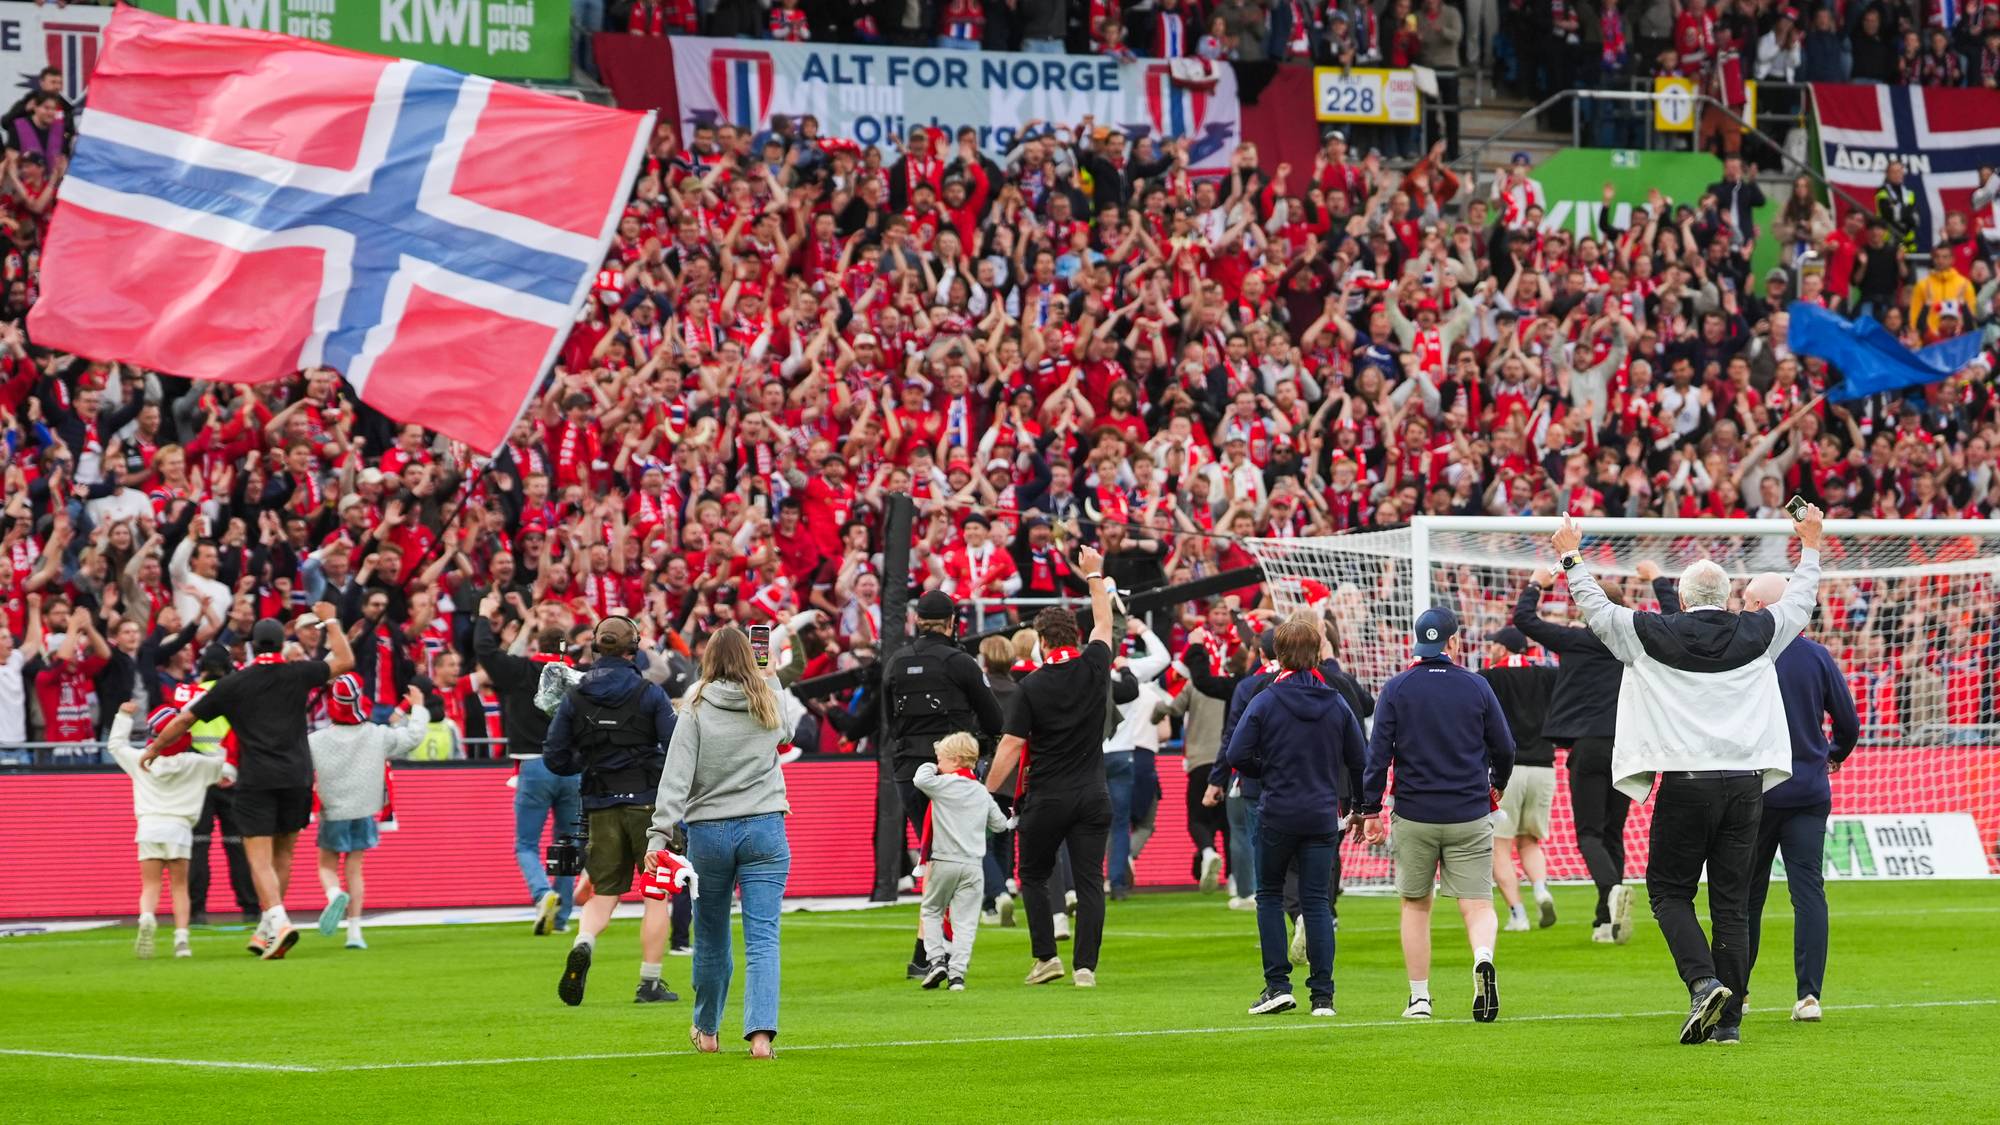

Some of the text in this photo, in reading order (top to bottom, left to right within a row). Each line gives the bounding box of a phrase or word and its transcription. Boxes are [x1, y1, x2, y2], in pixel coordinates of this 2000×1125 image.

[380, 0, 481, 47] KIWI
[488, 0, 534, 26] mini
[488, 25, 530, 56] pris
[803, 53, 1119, 91] ALT FOR NORGE
[1327, 86, 1374, 113] 228
[1875, 819, 1933, 847] mini
[1885, 849, 1934, 876] pris
